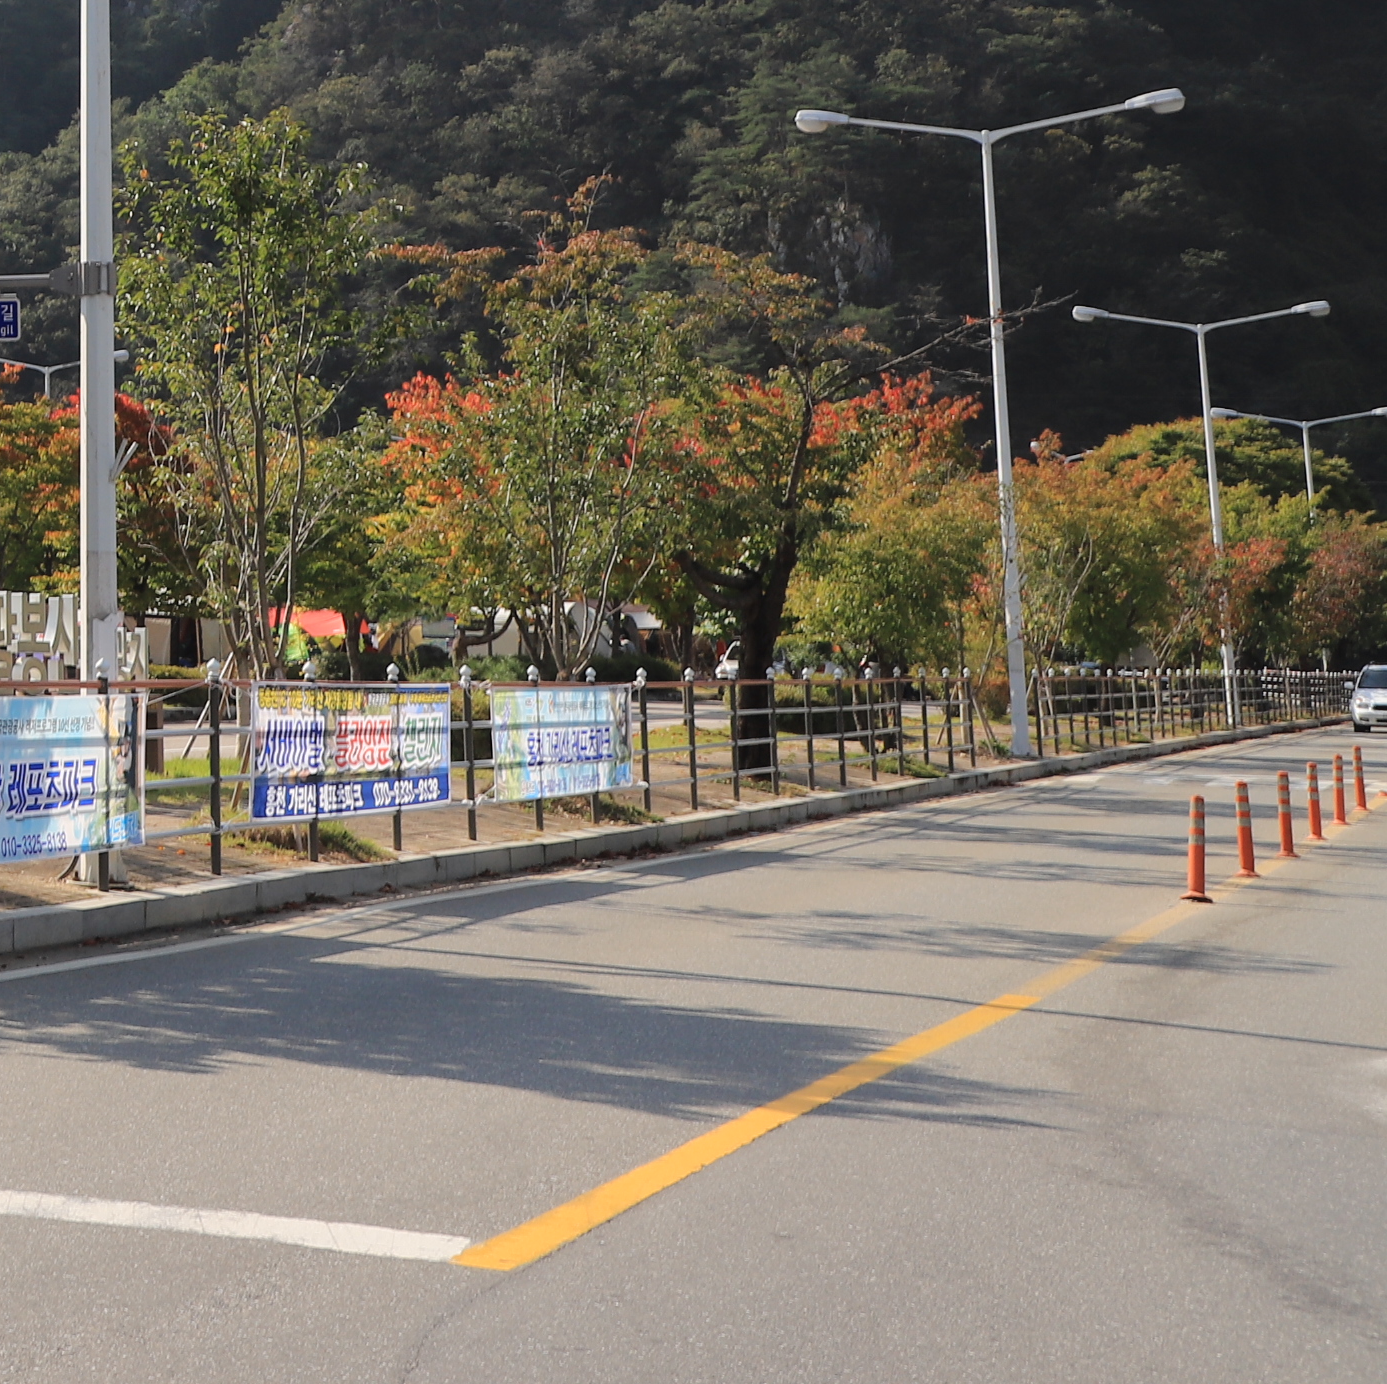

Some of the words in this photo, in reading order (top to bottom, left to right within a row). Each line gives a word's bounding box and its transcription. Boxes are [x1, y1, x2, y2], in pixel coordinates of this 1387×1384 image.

[6, 759, 97, 815] 레포츠파크
[266, 785, 286, 816] 홍천
[1, 831, 68, 858] 010-3325-8138
